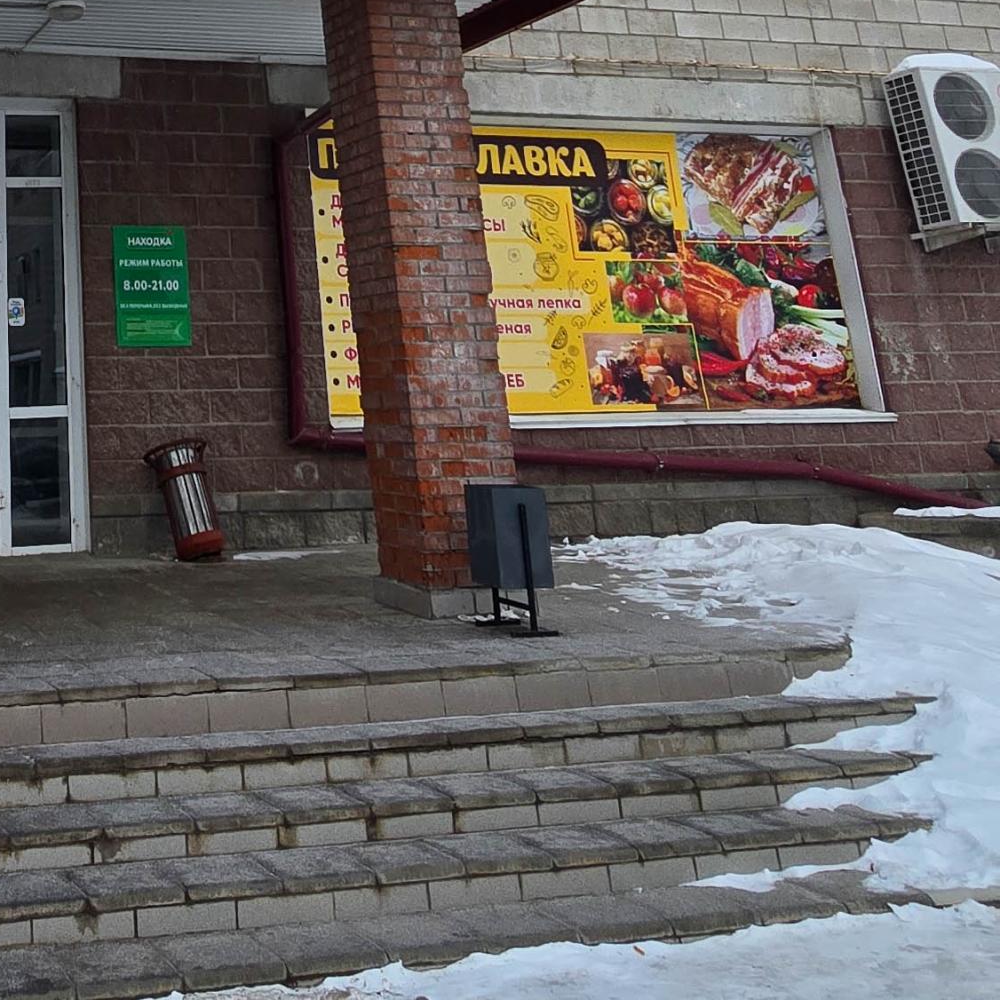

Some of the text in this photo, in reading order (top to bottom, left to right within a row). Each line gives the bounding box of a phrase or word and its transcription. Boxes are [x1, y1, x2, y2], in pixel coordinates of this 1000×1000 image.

[475, 143, 597, 177] ЛАВКА
[127, 237, 172, 247] НАХОДКА
[119, 259, 183, 267] РЕЖИМ РАБОТЫ
[123, 280, 179, 291] 8.00-21.00
[489, 298, 582, 310] учная лепка
[496, 323, 532, 334] еная
